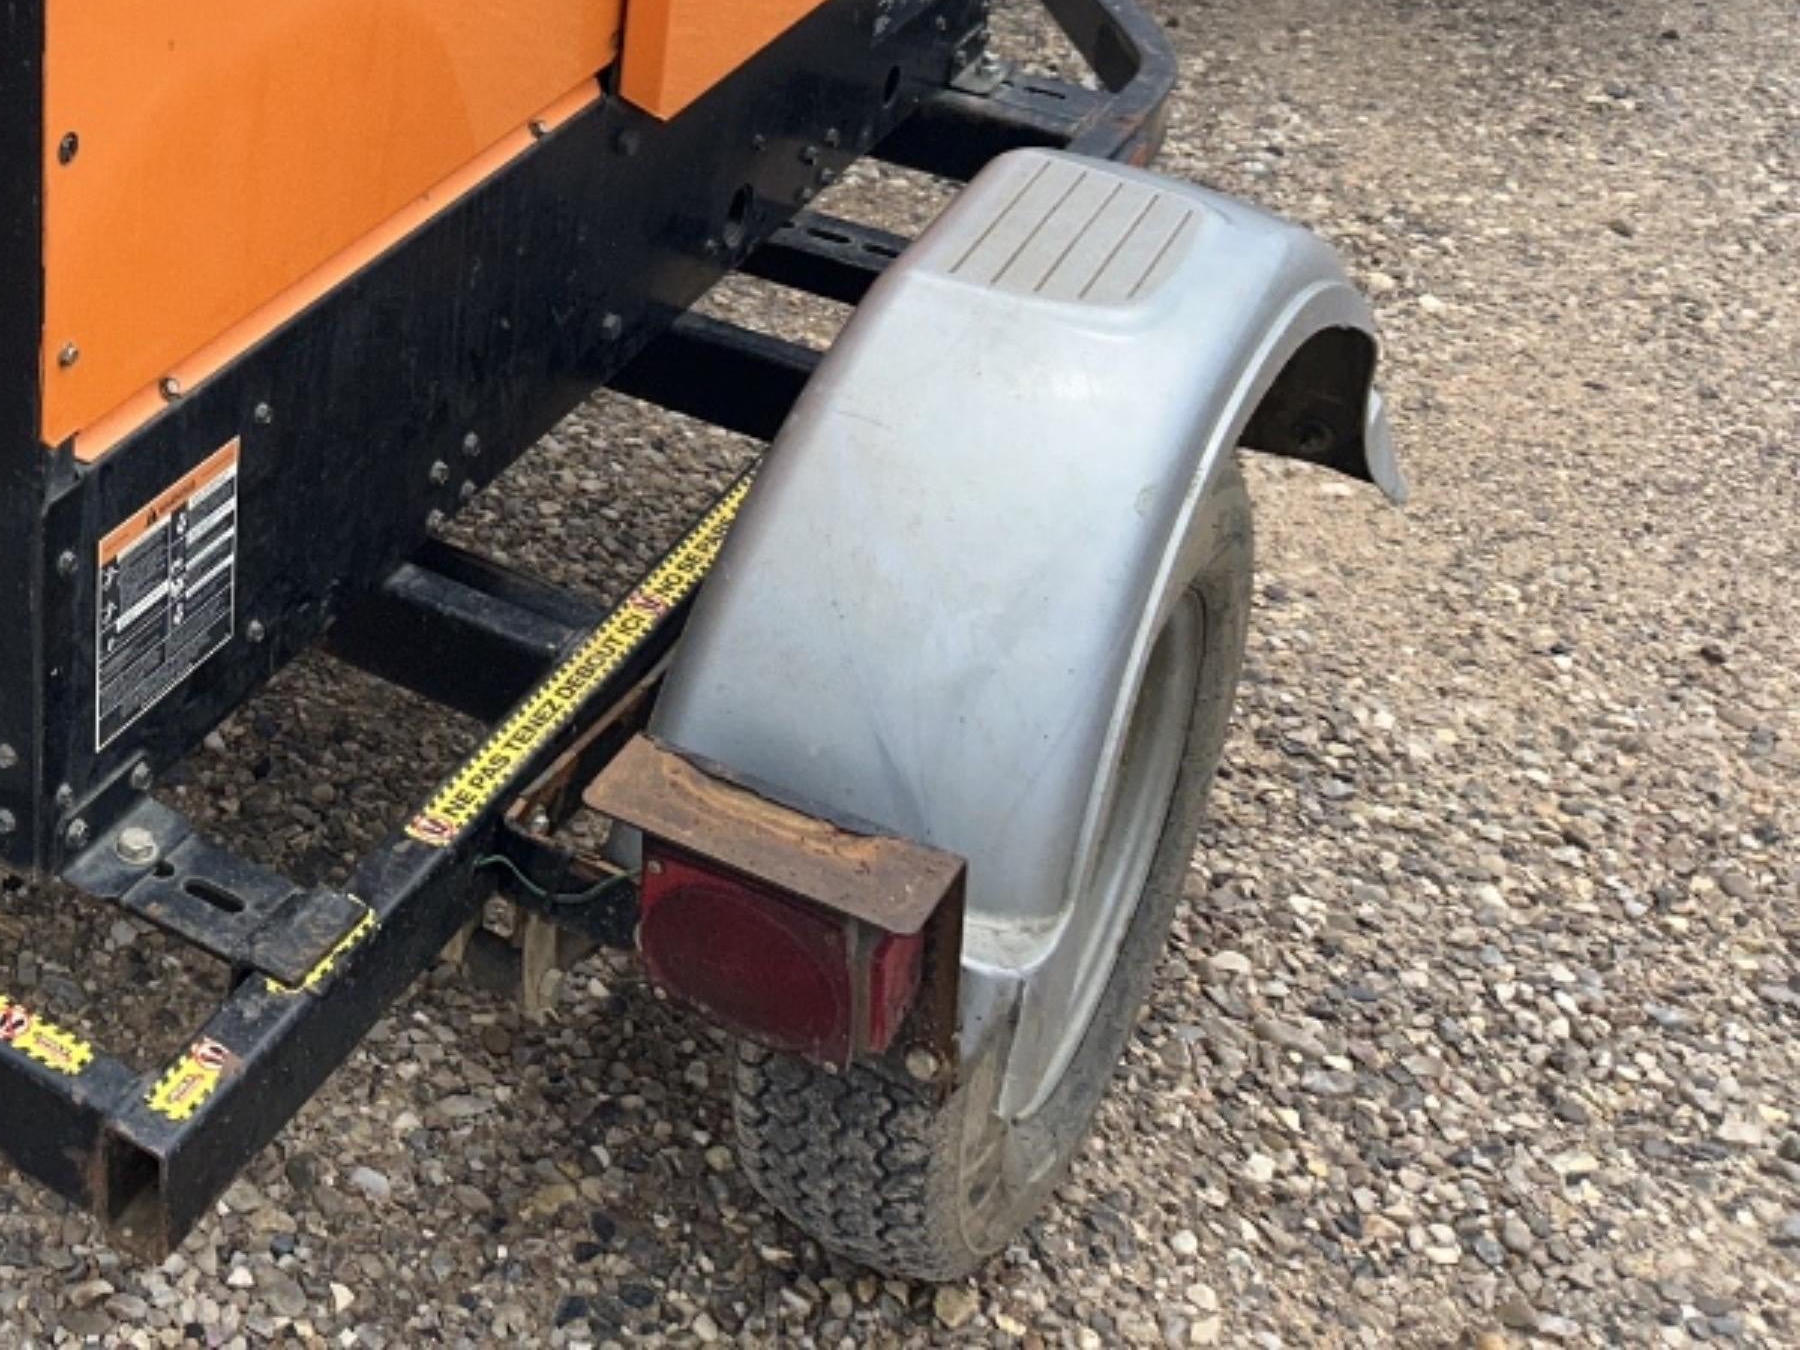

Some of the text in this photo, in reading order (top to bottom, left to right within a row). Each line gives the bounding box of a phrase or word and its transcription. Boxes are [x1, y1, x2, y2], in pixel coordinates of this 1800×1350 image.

[441, 789, 475, 819] NE
[468, 755, 511, 790] PAS
[502, 698, 564, 752] TENEZ
[555, 635, 621, 701] DEBOUT
